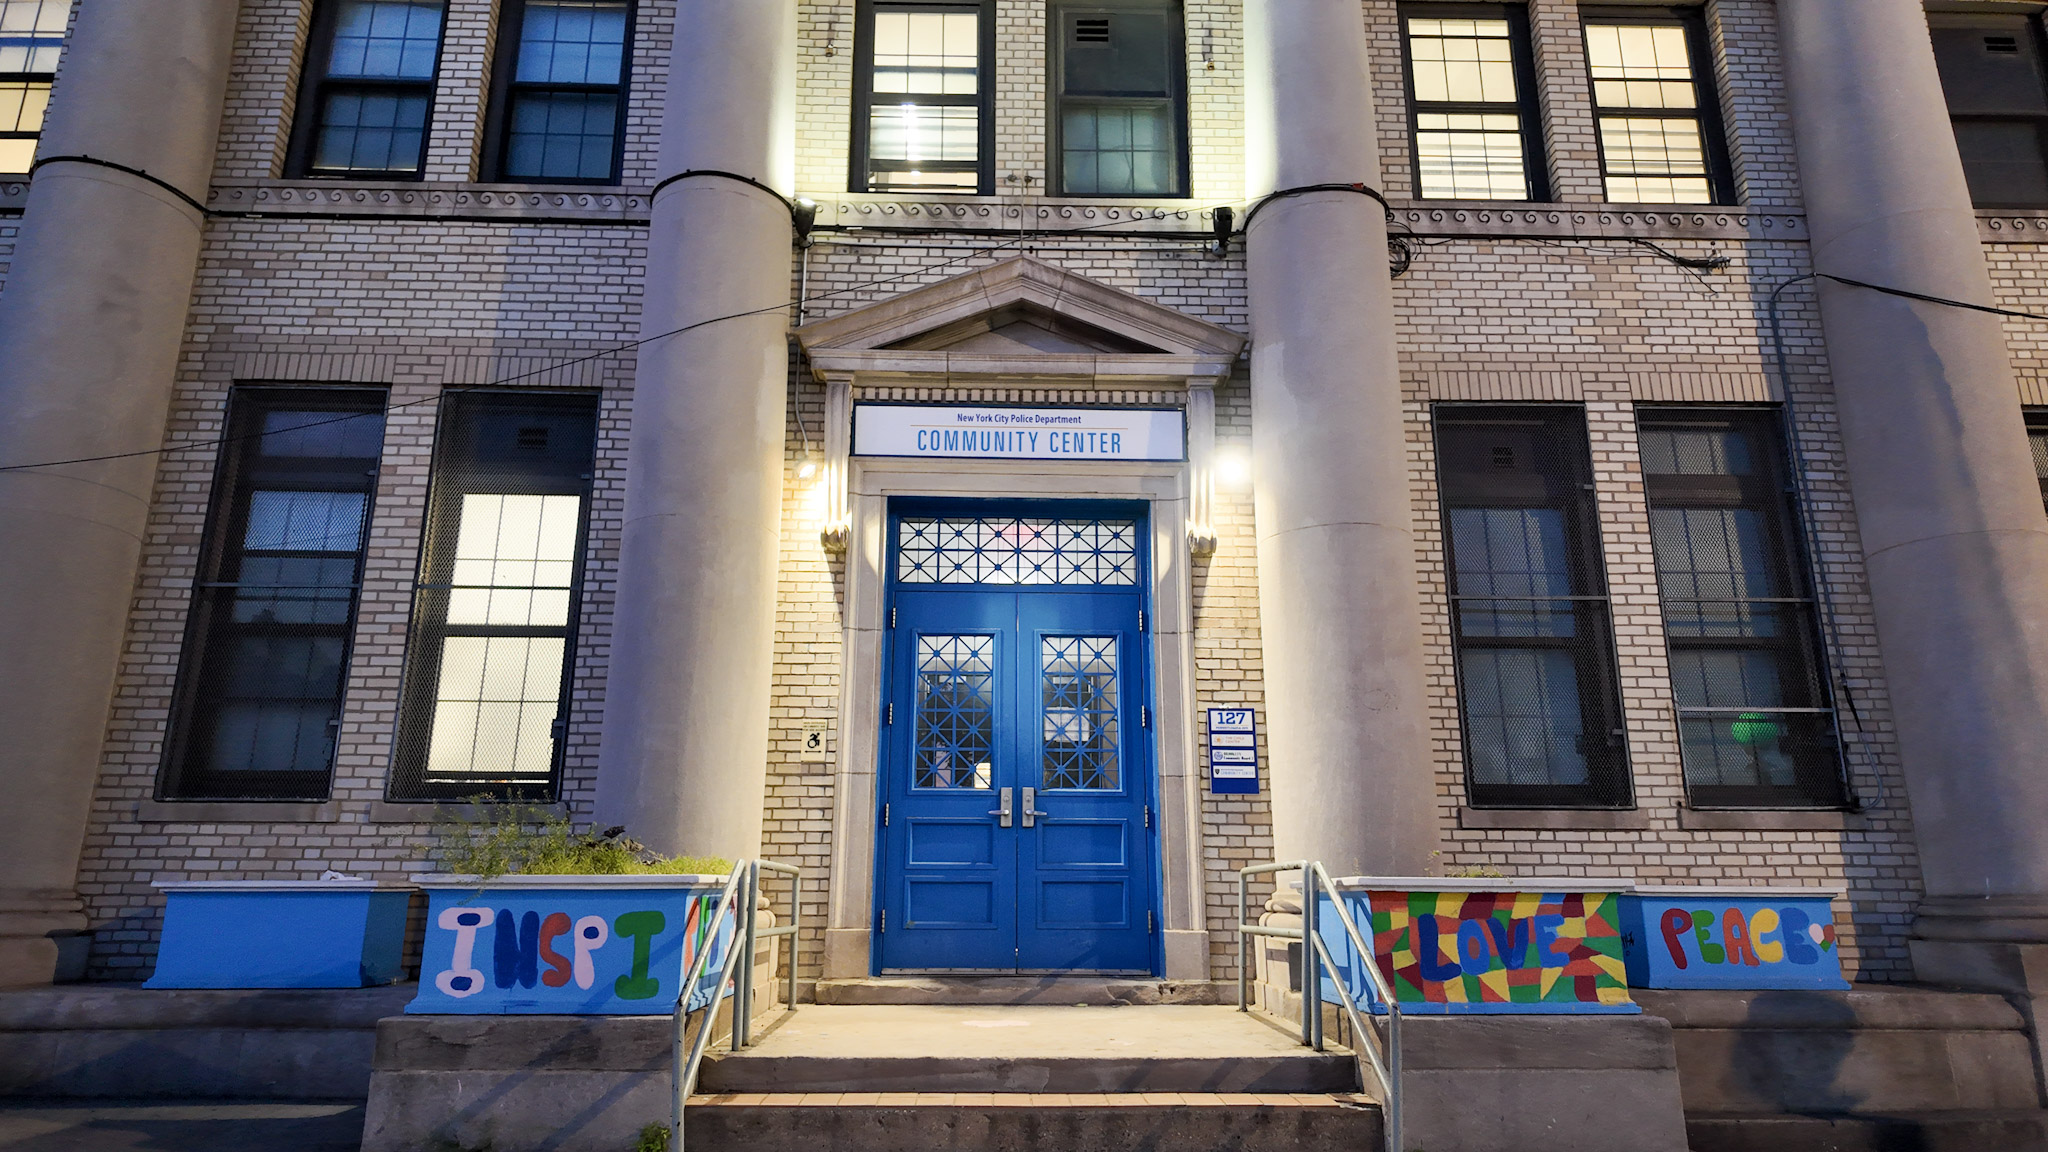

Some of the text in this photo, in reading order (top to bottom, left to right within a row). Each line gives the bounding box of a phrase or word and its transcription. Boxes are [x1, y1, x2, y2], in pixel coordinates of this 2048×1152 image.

[957, 413, 1082, 425] New York City Police Department
[918, 430, 1121, 453] COMMUNITY CENTER
[1217, 712, 1246, 724] 127
[1418, 913, 1570, 982] LOVE
[1661, 907, 1819, 970] PEACE
